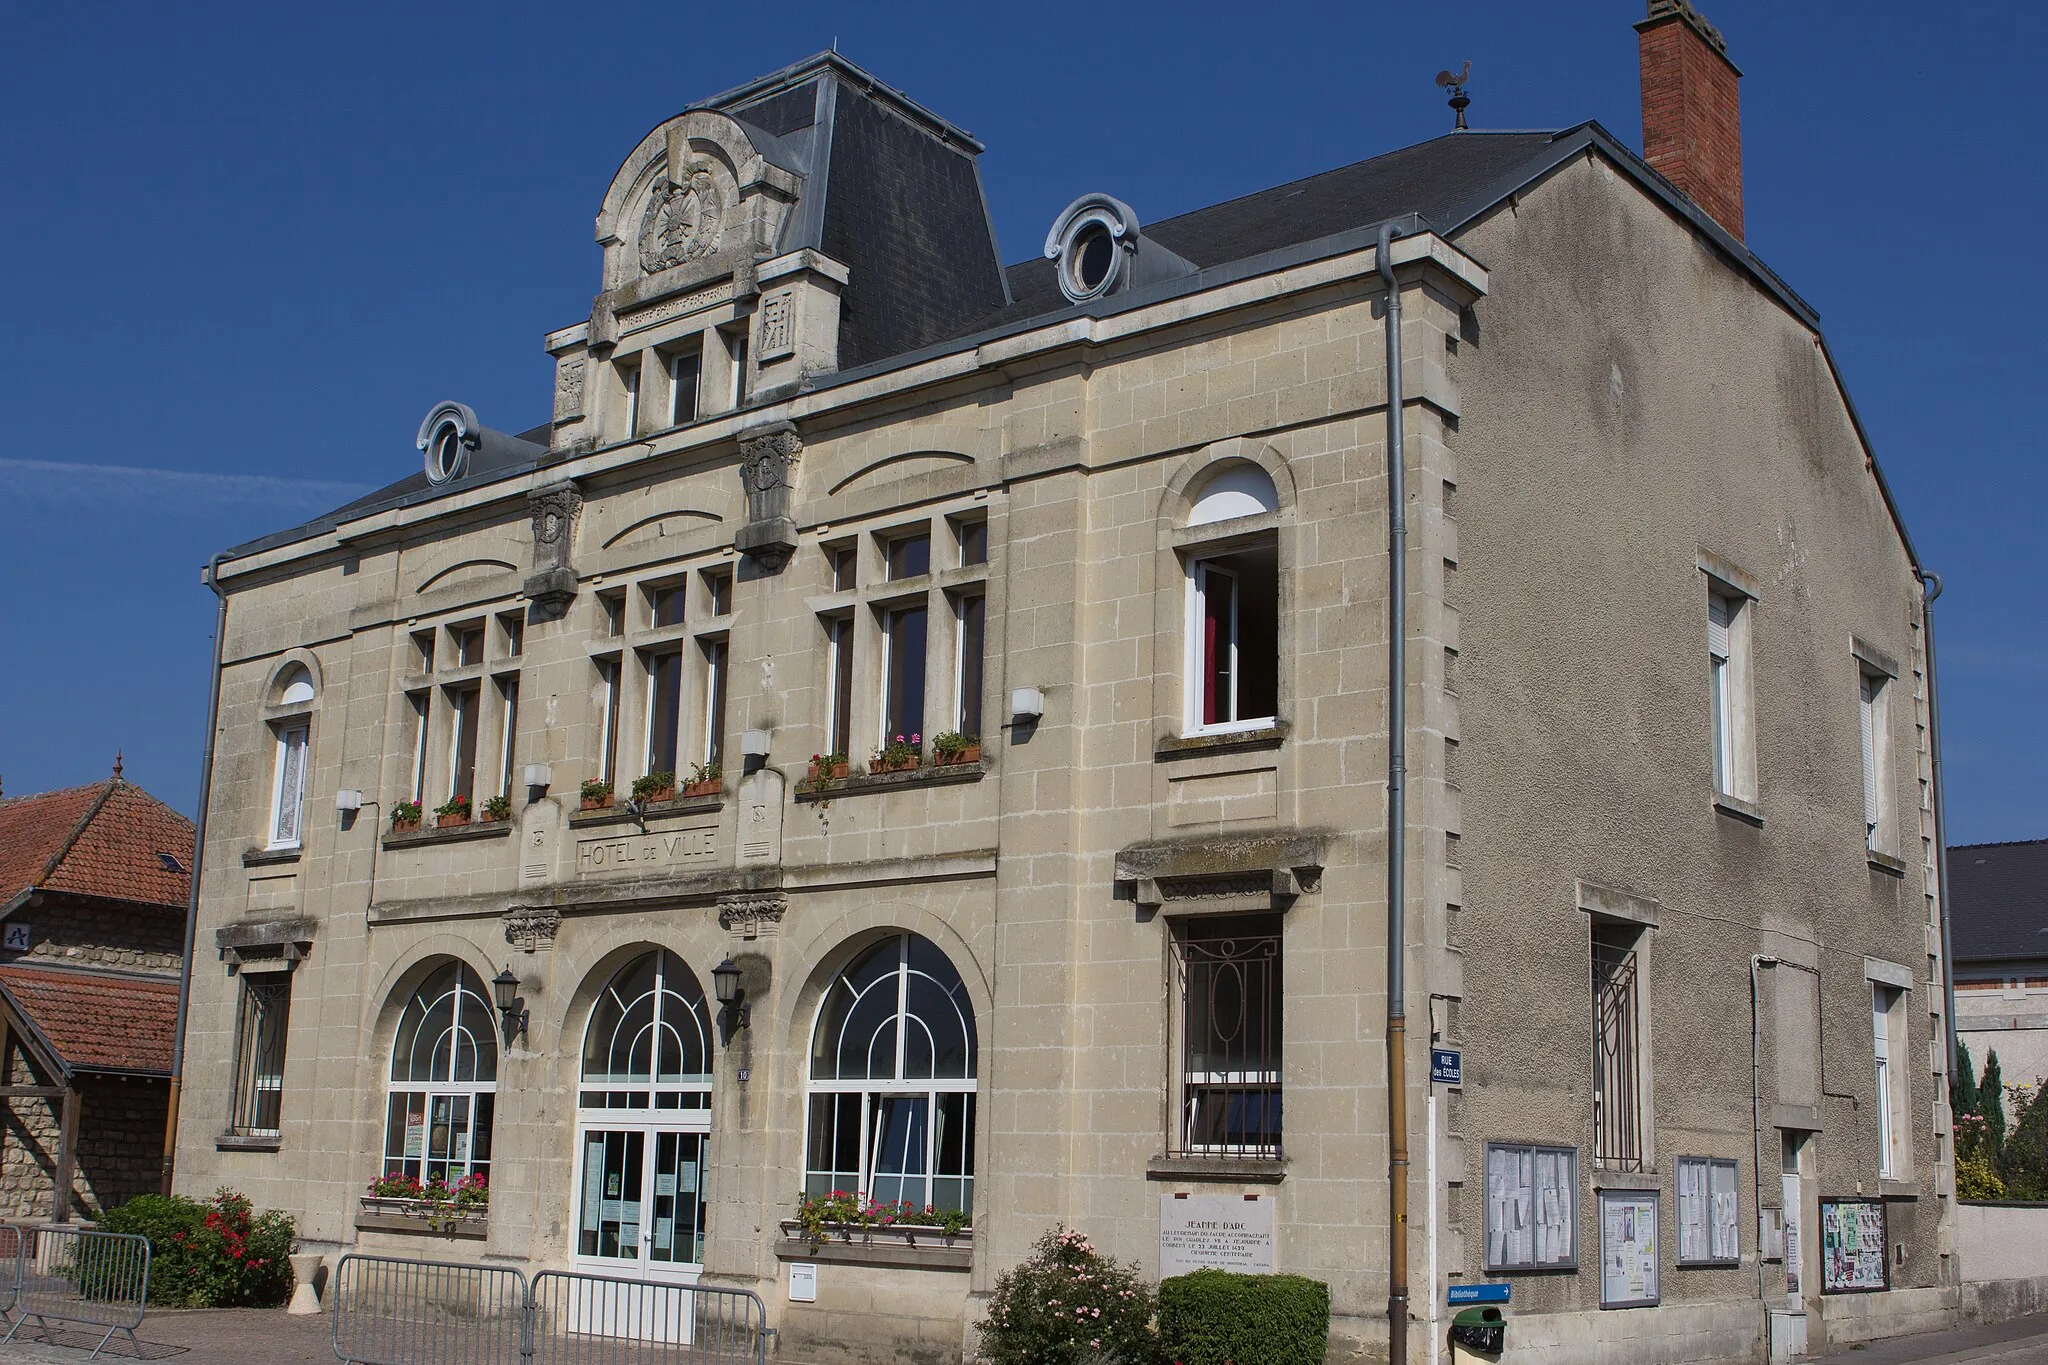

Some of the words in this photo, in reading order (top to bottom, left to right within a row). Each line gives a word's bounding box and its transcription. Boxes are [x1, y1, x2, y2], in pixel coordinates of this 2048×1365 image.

[580, 842, 636, 867] HOTEL
[664, 833, 714, 858] VILLE
[1441, 1056, 1452, 1065] RUE
[1434, 1067, 1442, 1077] des
[1443, 1066, 1460, 1078] ÉCOLES
[1185, 1221, 1219, 1229] JEANNE
[1223, 1222, 1247, 1230] D'ARC
